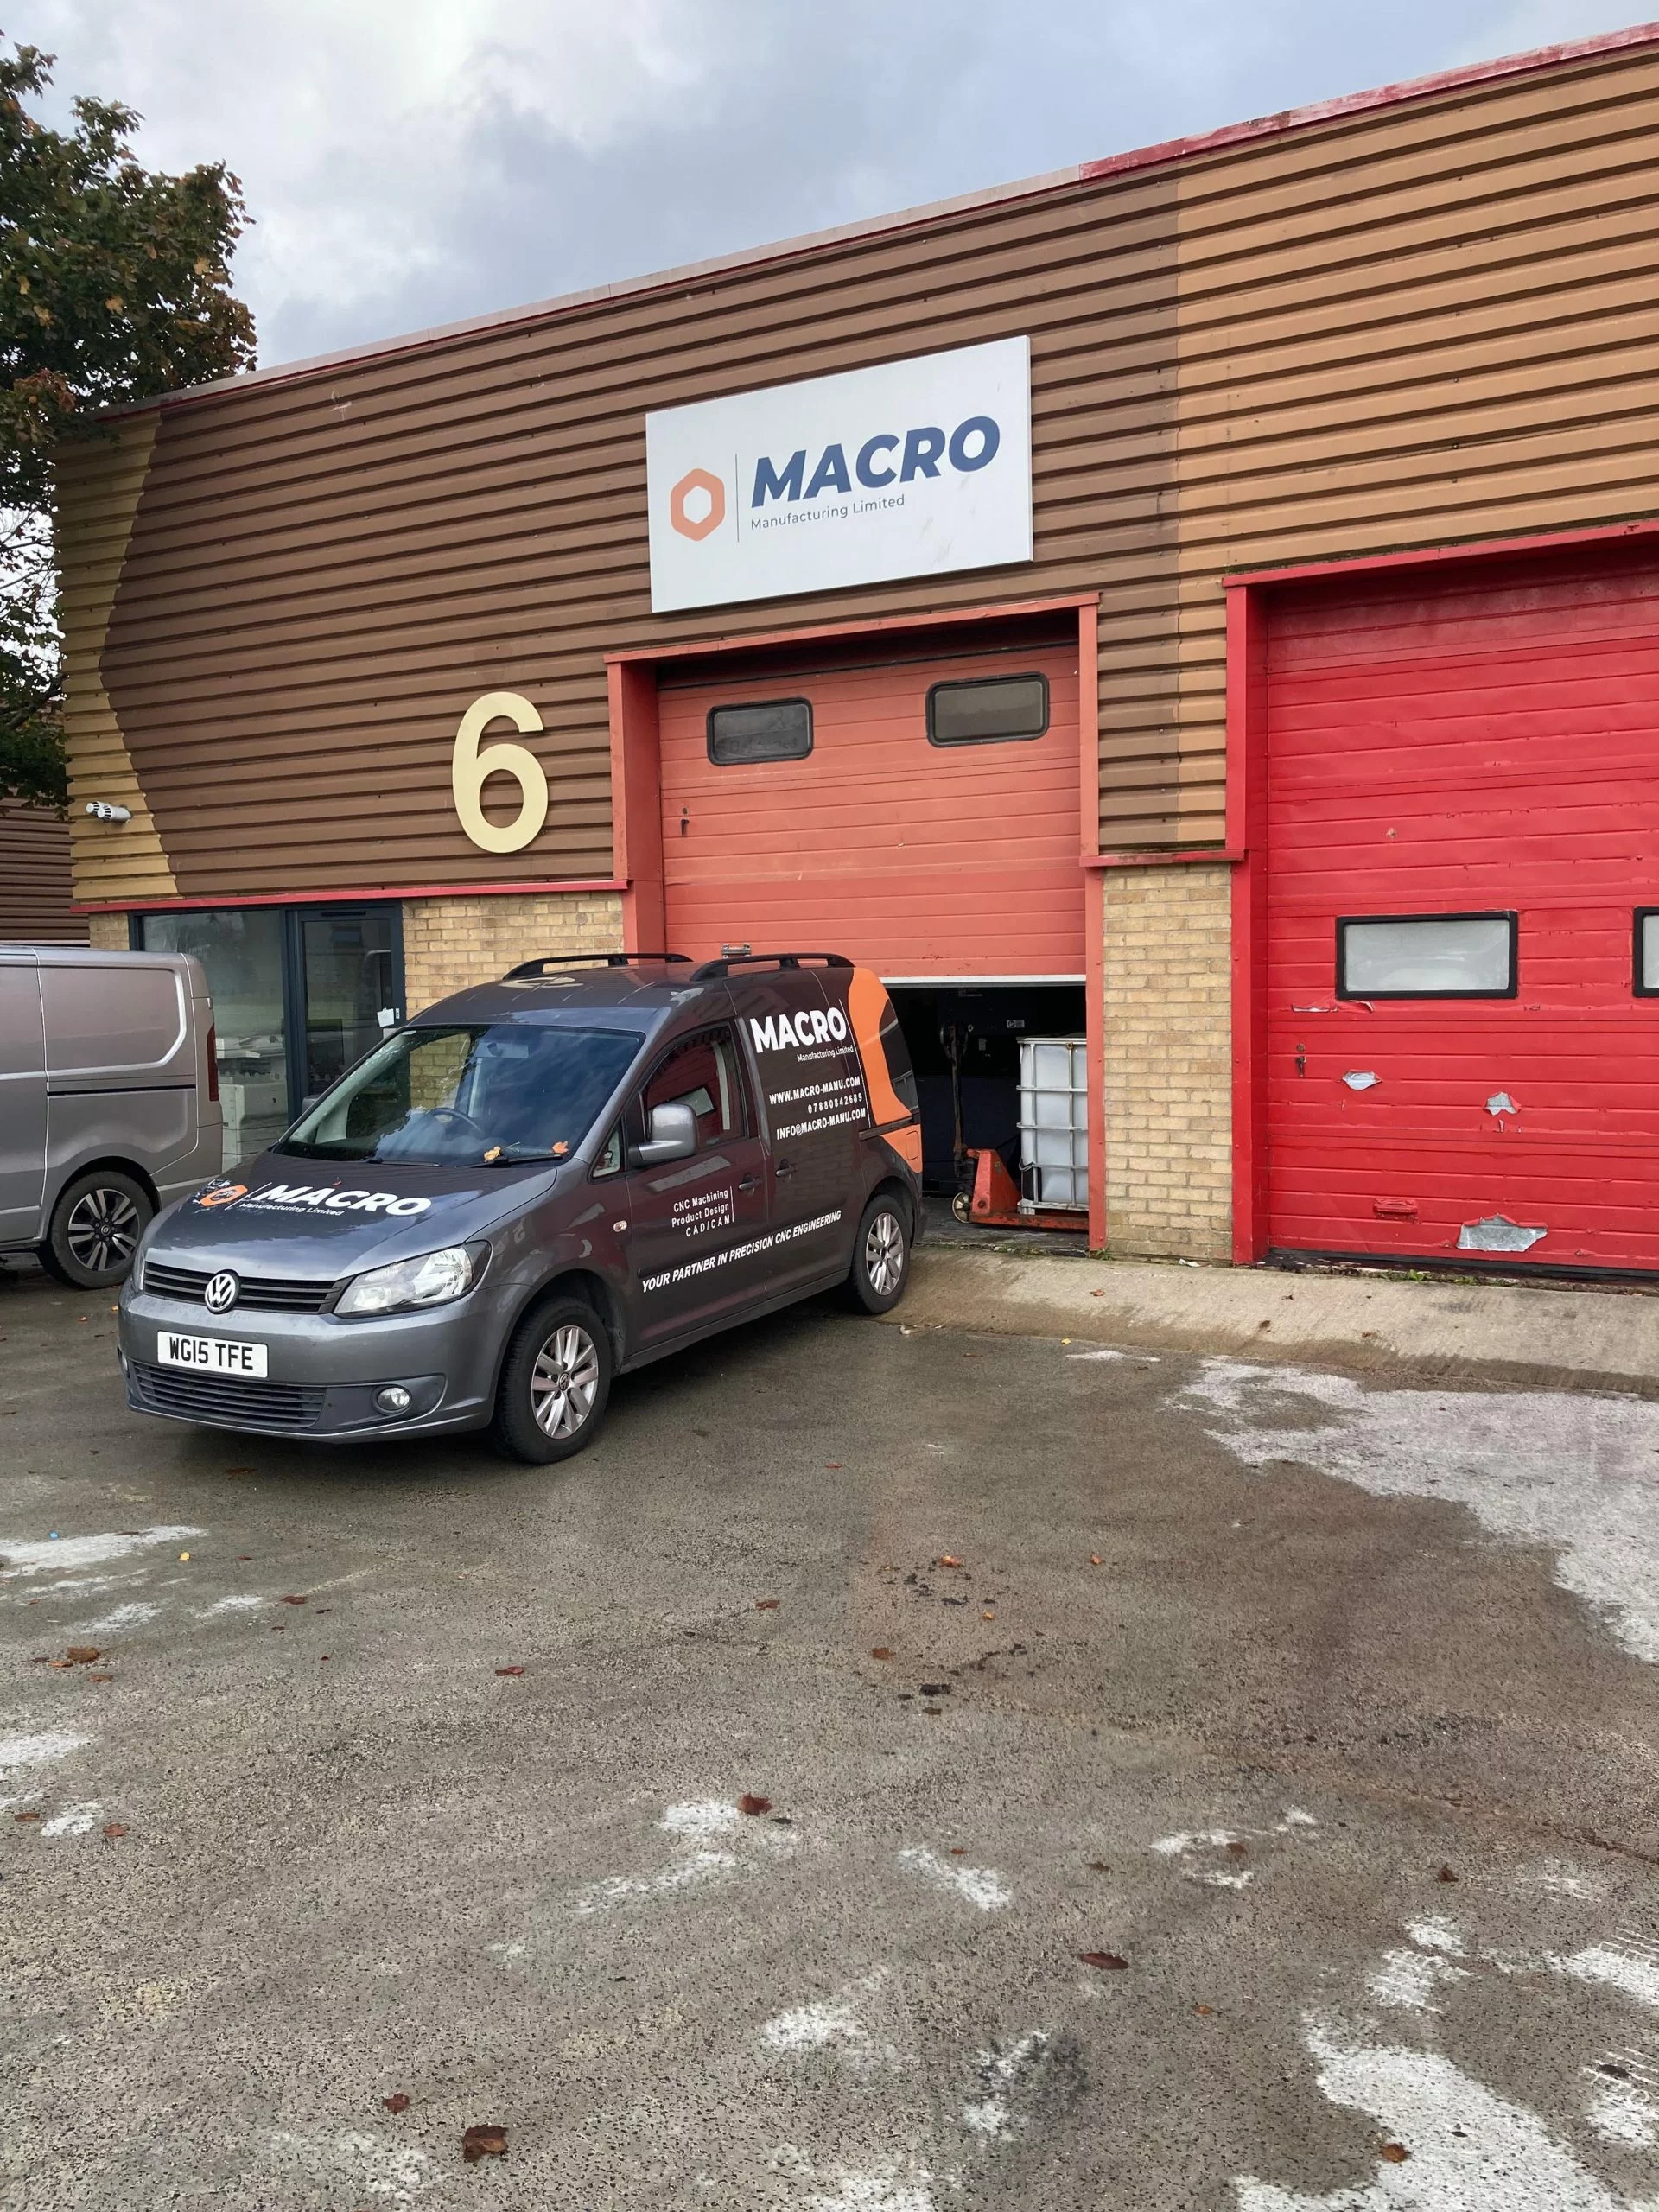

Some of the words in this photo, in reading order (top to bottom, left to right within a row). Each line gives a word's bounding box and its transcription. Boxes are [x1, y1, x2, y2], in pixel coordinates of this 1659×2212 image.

[751, 416, 1000, 508] MACRO
[751, 505, 848, 531] Manufacturing
[853, 494, 905, 515] Limited
[452, 691, 548, 853] 6
[750, 1007, 847, 1053] MACRO
[797, 1049, 835, 1062] Manufacturing
[836, 1045, 854, 1055] Limited
[769, 1076, 861, 1105] WWW.MACRO-MANU.COM
[808, 1092, 862, 1114] 07880842689
[776, 1108, 866, 1140] INFO@MACRO-MANU.COM
[239, 1202, 306, 1213] Manufacturing
[306, 1206, 345, 1216] Limited
[252, 1185, 432, 1216] MACRO
[671, 1211, 702, 1227] Product
[704, 1203, 729, 1218] Design
[673, 1202, 690, 1212] CNC
[692, 1189, 728, 1207] Machining
[685, 1214, 730, 1237] CAD/CAM
[642, 1273, 670, 1293] YOUR
[671, 1257, 715, 1283] PARTNER
[717, 1252, 728, 1266] IN
[729, 1236, 773, 1262] PRECISION
[775, 1229, 791, 1243] CNC
[792, 1210, 842, 1237] ENGINEERING
[169, 1337, 208, 1364] WG15
[215, 1343, 253, 1370] TFE
